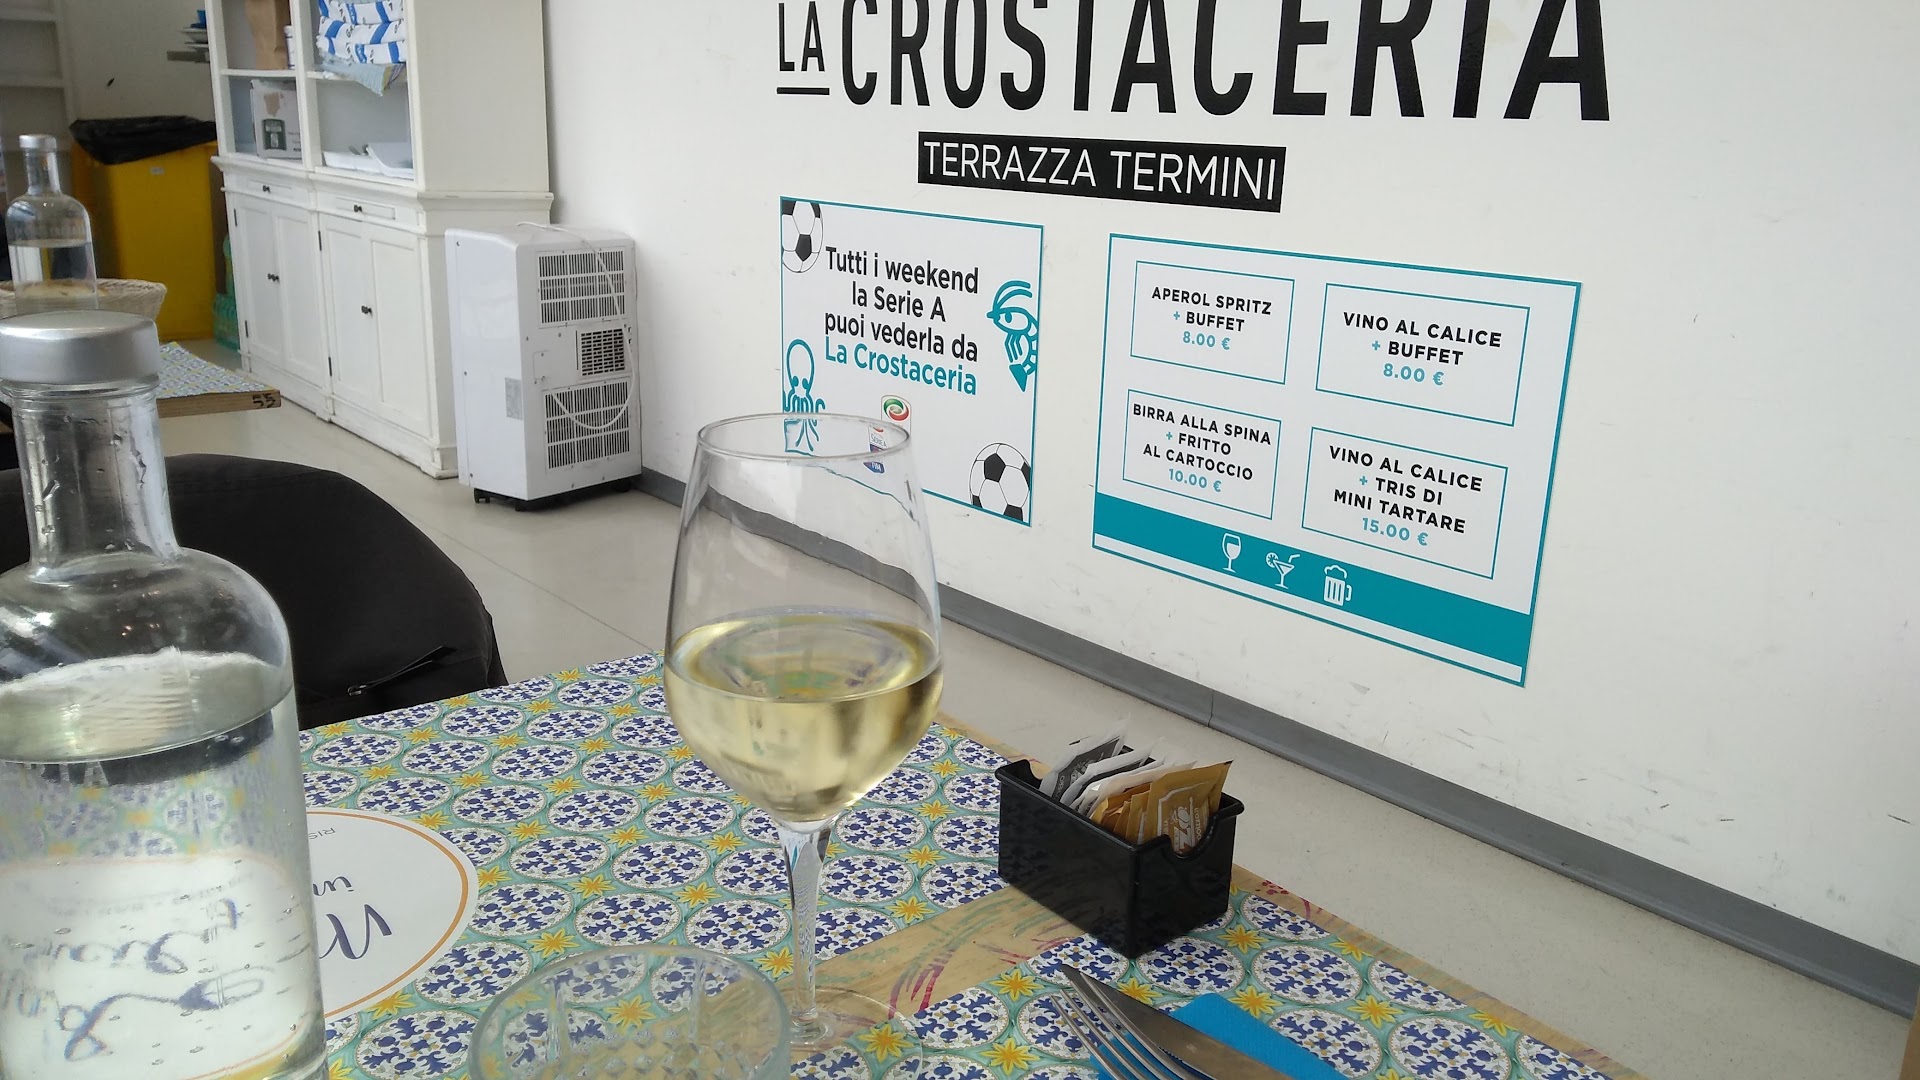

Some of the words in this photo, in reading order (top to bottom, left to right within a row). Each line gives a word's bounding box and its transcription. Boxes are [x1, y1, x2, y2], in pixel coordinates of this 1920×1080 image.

[779, 1, 825, 72] LA
[924, 141, 1096, 187] TERRAZZA
[1111, 150, 1276, 200] TERMINI
[826, 246, 867, 275] Tutti
[874, 253, 878, 277] i
[885, 260, 978, 294] weekend
[853, 281, 867, 307] la
[874, 286, 923, 317] Serie
[930, 296, 946, 322] A
[1152, 287, 1210, 306] APEROL
[1216, 296, 1272, 315] SPRITZ
[825, 313, 864, 337] puoi
[871, 322, 944, 354] vederla
[952, 334, 977, 362] da
[1186, 311, 1244, 331] BUFFET
[1344, 312, 1388, 331] VINO
[1395, 320, 1419, 336] AL
[1428, 324, 1502, 347] CALICE
[1183, 331, 1215, 348] 8.00
[1222, 337, 1230, 350] €
[1388, 341, 1463, 365] BUFFET
[826, 336, 847, 364] La
[854, 343, 976, 395] Crostaceria
[1383, 363, 1425, 382] 8.00
[1433, 371, 1444, 385] €
[1133, 404, 1175, 423] BIRRA
[1180, 415, 1218, 433] ALLA
[1224, 424, 1271, 445] SPINA
[1179, 433, 1231, 455] FRITTO
[1143, 444, 1160, 458] AL
[1166, 449, 1253, 480] CARTOCCIO
[1330, 446, 1373, 466] VINO
[1380, 458, 1402, 474] AL
[1411, 464, 1482, 491] CALICE
[1169, 469, 1207, 488] 10.00
[1213, 480, 1222, 492] €
[1376, 478, 1416, 499] TRIS
[1424, 489, 1442, 505] DI
[1334, 489, 1372, 510] MINI
[1380, 500, 1466, 533] TARTARE
[1363, 518, 1410, 541] 15.00
[1417, 532, 1428, 546] €
